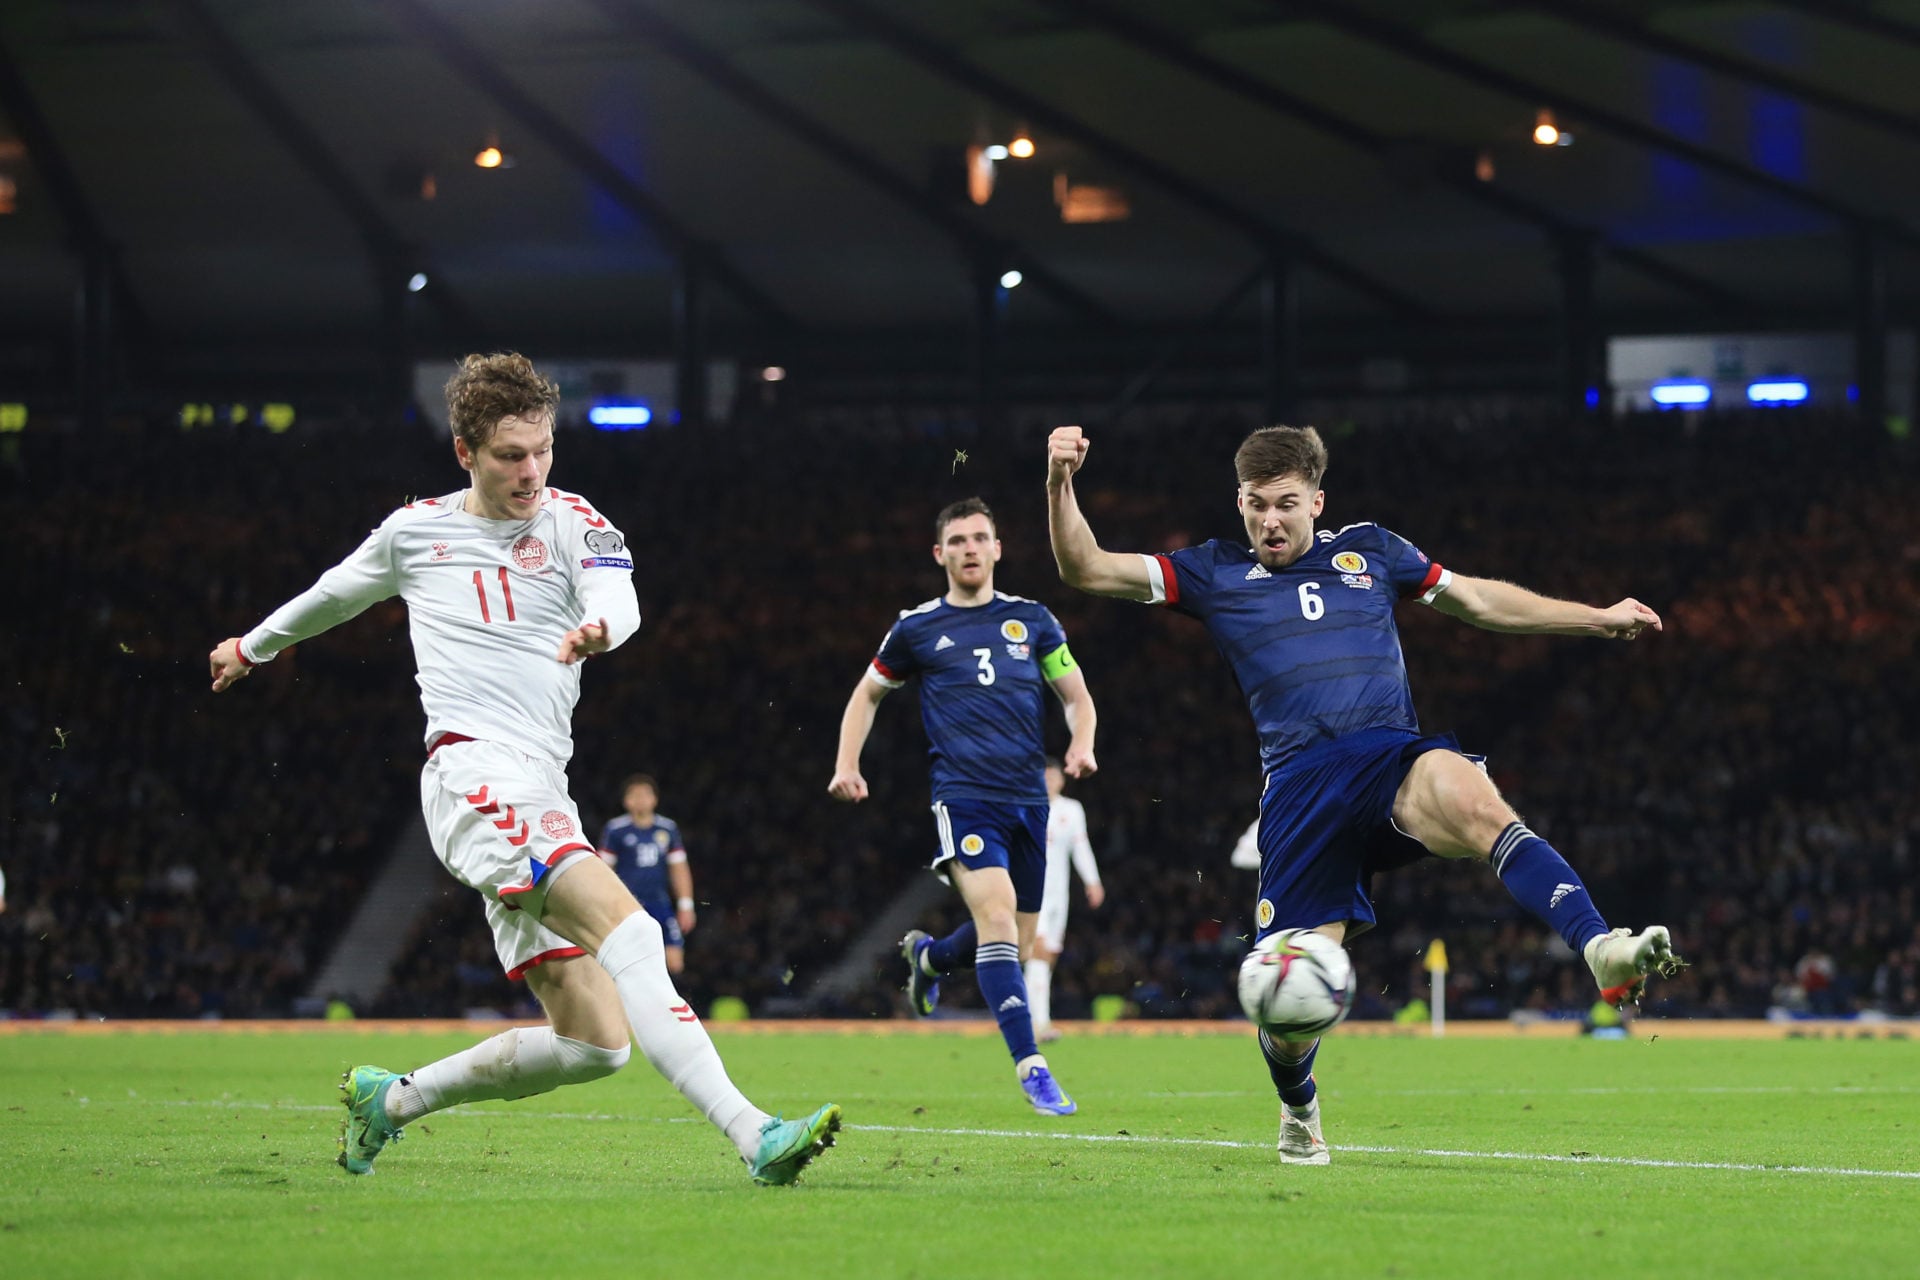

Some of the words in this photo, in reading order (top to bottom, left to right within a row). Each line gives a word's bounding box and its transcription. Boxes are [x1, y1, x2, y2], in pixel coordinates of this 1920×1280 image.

[519, 547, 541, 559] DBU
[597, 559, 631, 567] RESPECT
[473, 566, 516, 623] 11
[1298, 582, 1325, 621] 6
[973, 648, 996, 686] 3
[1060, 650, 1071, 667] C
